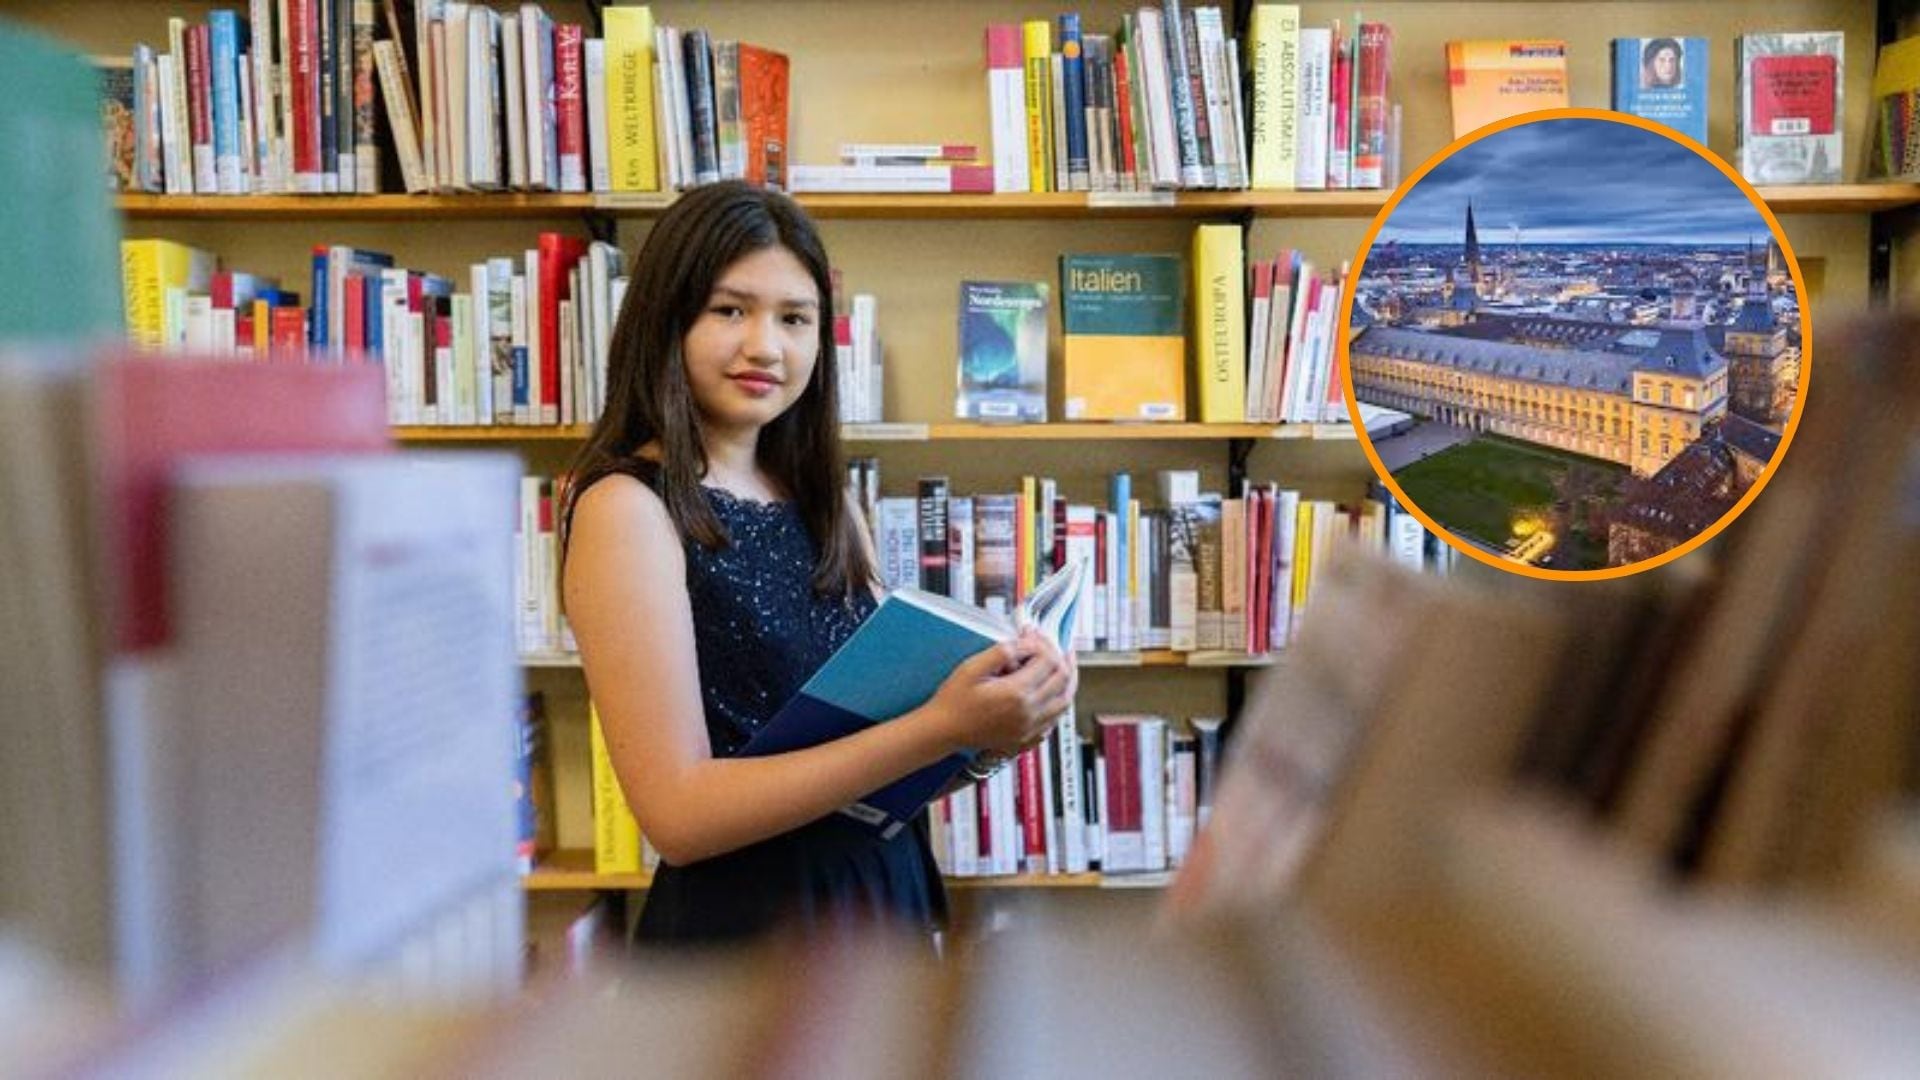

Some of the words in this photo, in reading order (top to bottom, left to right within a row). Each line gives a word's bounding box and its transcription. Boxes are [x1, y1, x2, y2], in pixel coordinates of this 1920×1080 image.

[622, 49, 639, 147] WELTKRIEGE
[1281, 41, 1295, 160] ABSOLUTISMUS
[1070, 268, 1142, 292] Italien
[1213, 276, 1229, 382] OSTEUROPA
